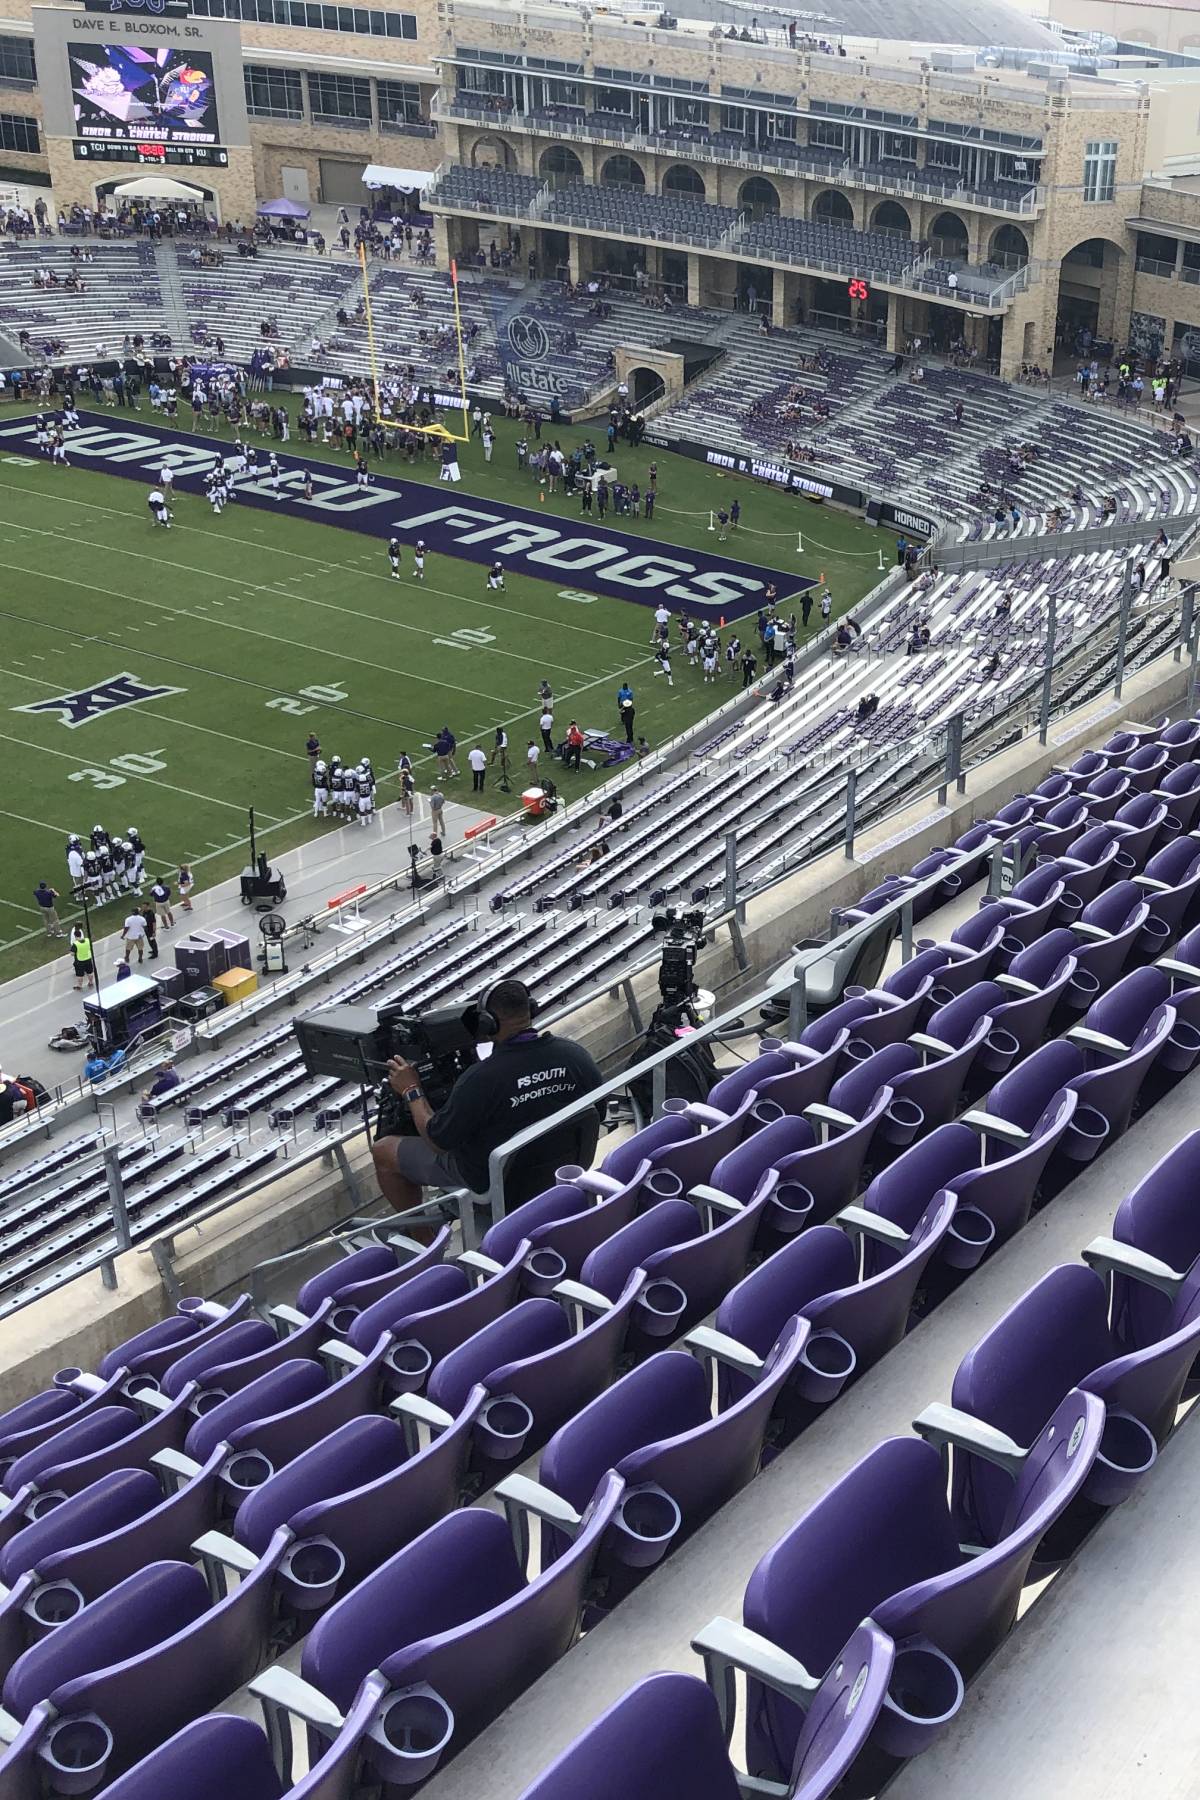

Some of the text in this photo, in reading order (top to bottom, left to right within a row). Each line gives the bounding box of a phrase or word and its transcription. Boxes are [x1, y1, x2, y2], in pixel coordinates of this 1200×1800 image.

[73, 18, 203, 38] DAVE E. BLOXOM, SR.
[171, 131, 215, 142] STADIUM
[80, 145, 88, 156] 0
[90, 143, 105, 152] TCU
[196, 148, 207, 157] KU
[220, 152, 227, 163] 0
[848, 279, 868, 300] 25
[506, 361, 569, 393] Allstate
[751, 463, 789, 484] CARTER
[792, 475, 834, 498] STADIUM
[894, 509, 930, 534] HORNED
[391, 505, 766, 606] FROGS
[431, 628, 497, 651] 10
[265, 684, 349, 716] 20
[67, 753, 168, 790] 30
[186, 967, 200, 975] TCU
[517, 1067, 567, 1089] FS SOUTH
[519, 1083, 576, 1103] SPORTSOUTH
